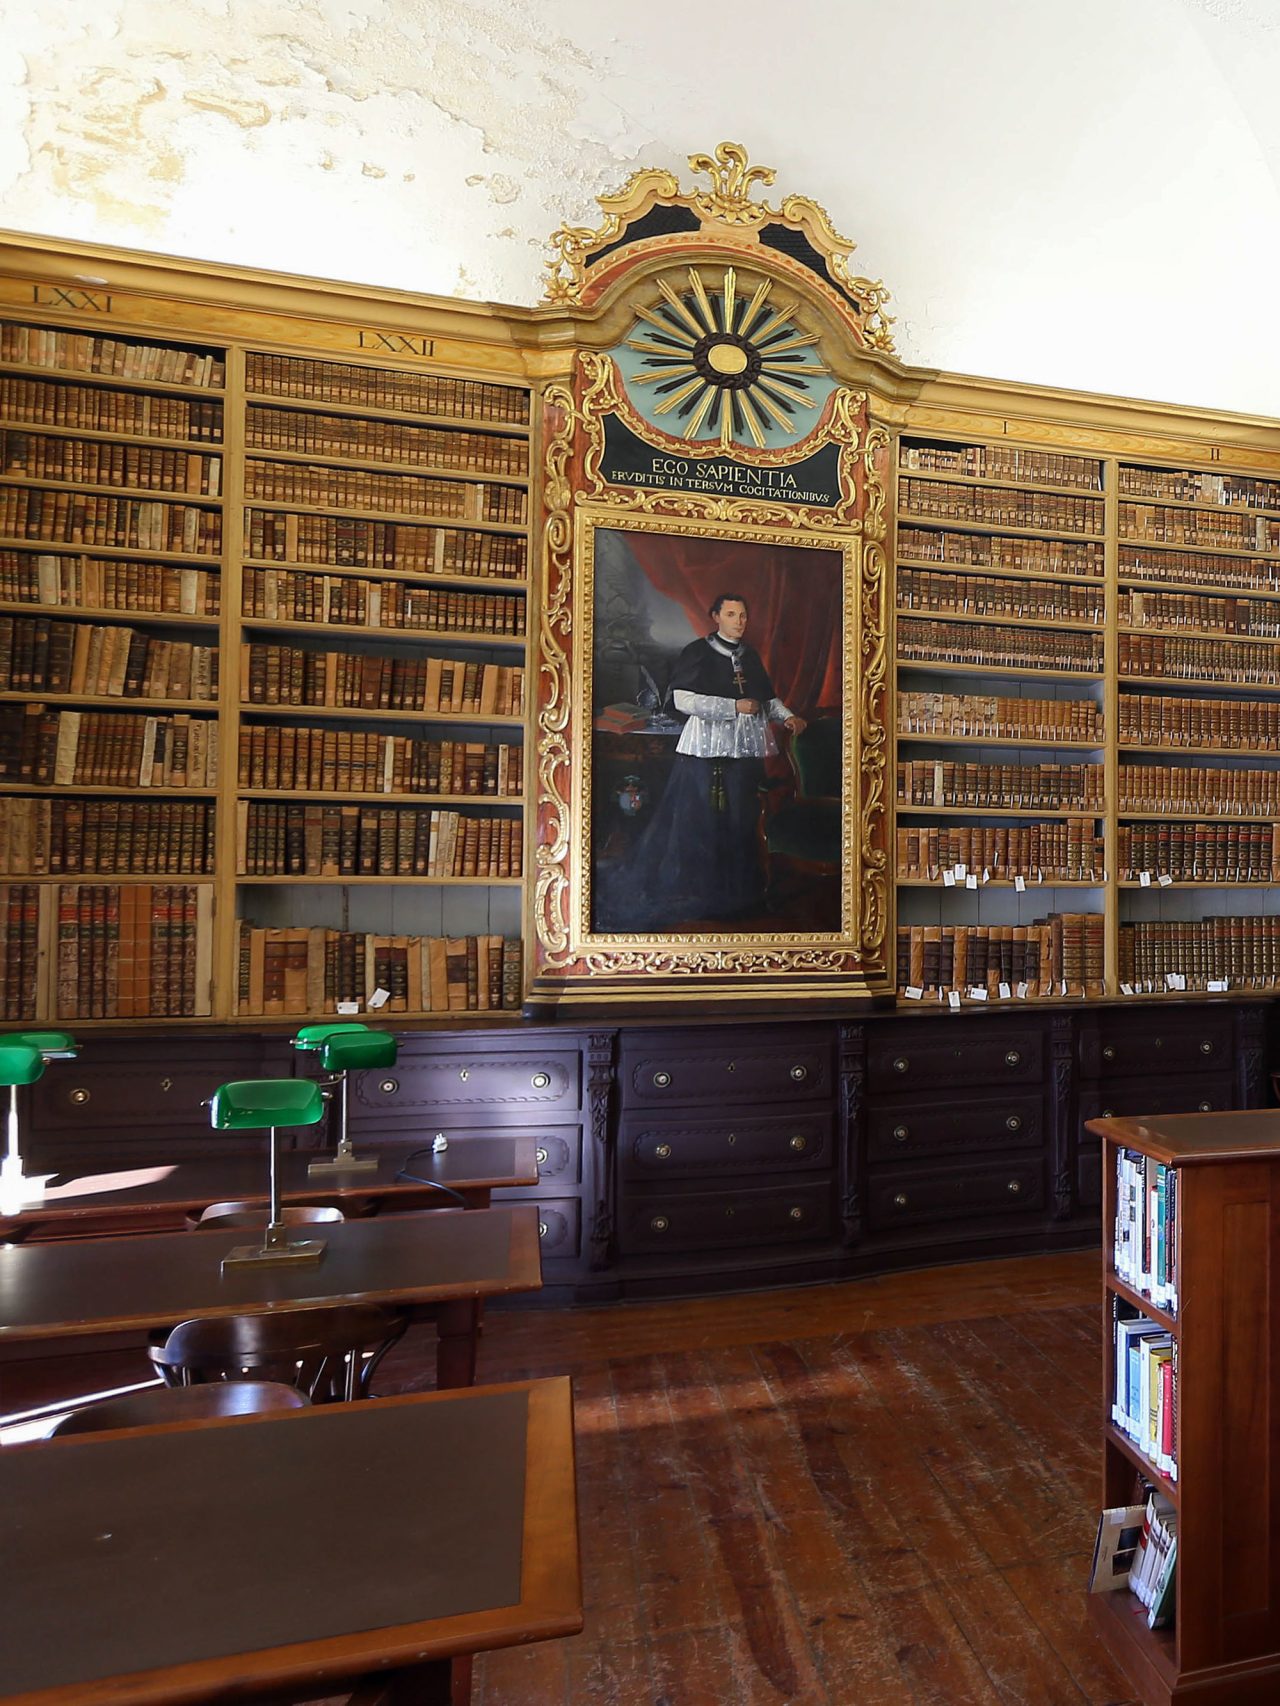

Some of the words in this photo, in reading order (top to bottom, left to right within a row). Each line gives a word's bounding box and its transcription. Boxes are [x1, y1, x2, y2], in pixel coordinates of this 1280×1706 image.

[32, 285, 113, 313] LXXI
[358, 331, 435, 357] LXXII
[1210, 447, 1220, 461] II
[611, 470, 665, 486] ERVDITIS
[739, 484, 830, 503] COGITATIONIBVS
[652, 458, 688, 476] EGO
[696, 463, 798, 488] SAPIENTIA
